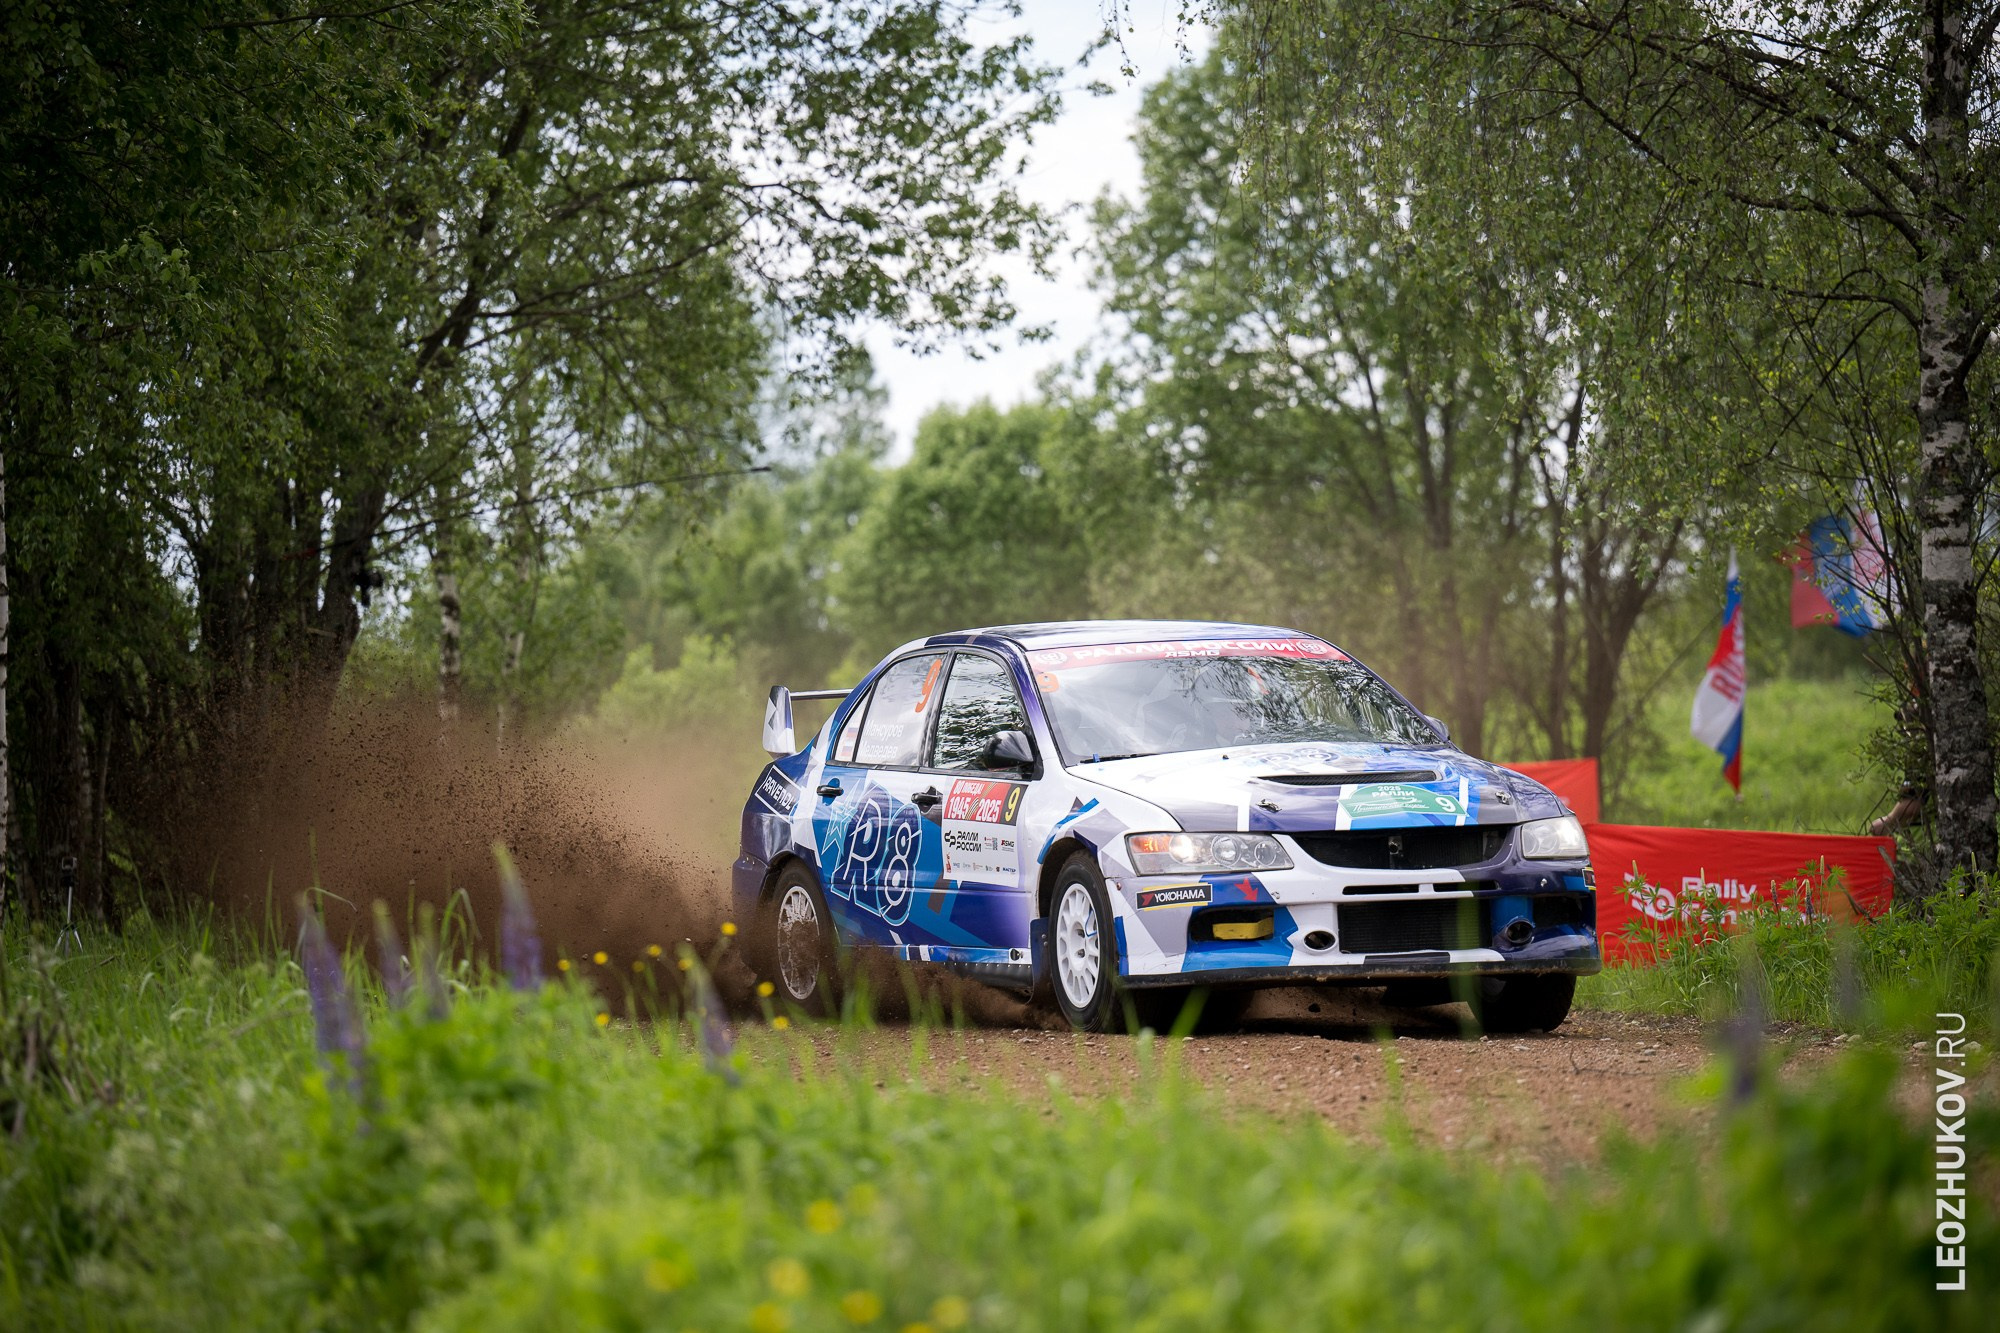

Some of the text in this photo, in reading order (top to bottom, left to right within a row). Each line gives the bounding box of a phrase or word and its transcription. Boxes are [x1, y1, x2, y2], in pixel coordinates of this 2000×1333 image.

[1072, 640, 1296, 660] РАЛЛИ РОССИИ
[915, 658, 942, 713] 9
[1037, 672, 1059, 693] 9
[762, 776, 795, 811] RAVENOL
[953, 780, 966, 794] 80
[1371, 790, 1415, 798] РАЛЛИ
[947, 796, 1002, 823] 1945 2025
[1004, 786, 1021, 822] 9
[1435, 797, 1456, 812] 9
[956, 830, 979, 842] РАЛЛИ
[832, 783, 922, 925] R8
[955, 841, 982, 853] РОССИИ
[1154, 889, 1206, 903] YOKOHAMA
